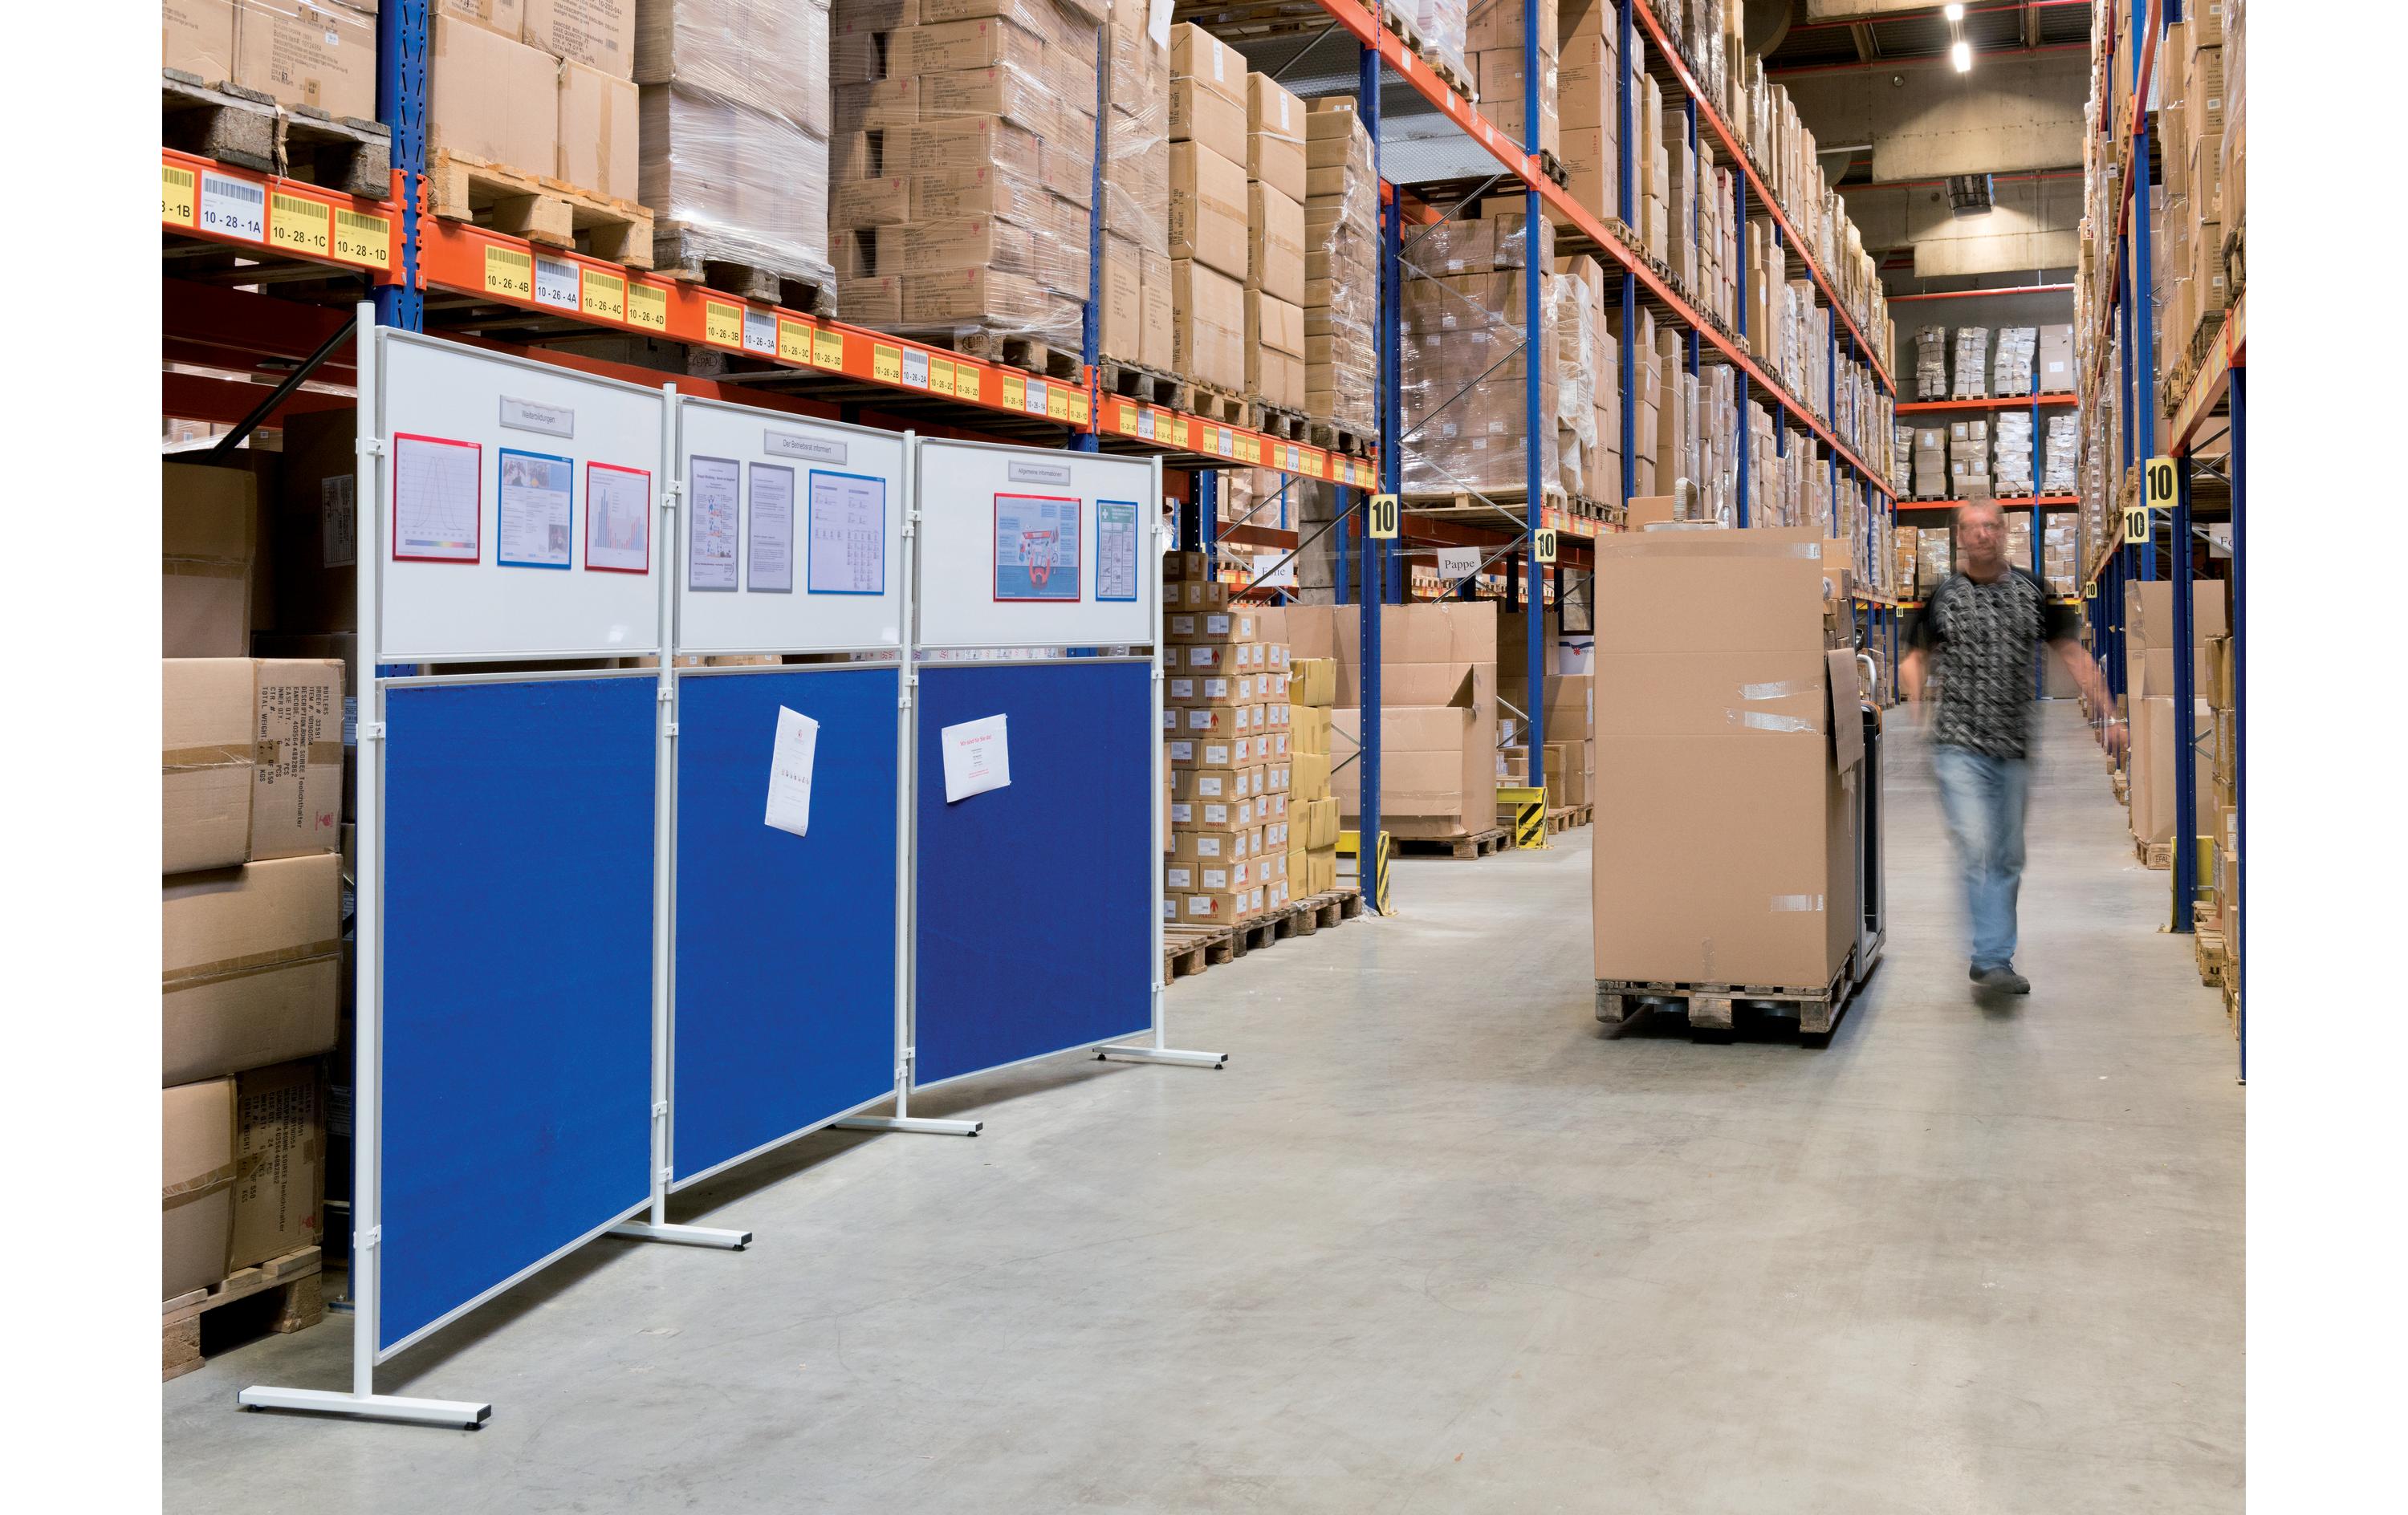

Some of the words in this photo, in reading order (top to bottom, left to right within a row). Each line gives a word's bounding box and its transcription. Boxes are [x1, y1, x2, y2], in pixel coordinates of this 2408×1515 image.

[177, 204, 190, 217] 1B
[204, 210, 216, 224] 10
[226, 215, 238, 228] 28
[248, 221, 261, 234] 1A
[273, 227, 284, 239] 10
[294, 231, 305, 244] 28
[314, 234, 326, 248] 1C
[337, 240, 348, 253] 10
[356, 245, 367, 257] 28
[376, 248, 386, 261] 1D
[488, 274, 496, 285] 10
[504, 278, 513, 289] 26
[519, 281, 529, 293] 4B
[538, 286, 546, 297] 10
[553, 290, 561, 300] 26
[567, 292, 577, 304] 4A
[585, 298, 593, 308] 10
[599, 301, 607, 311] 26
[612, 303, 622, 315] 4C
[629, 309, 637, 319] 10
[643, 311, 650, 322] 26
[655, 315, 664, 325] 4D
[708, 327, 714, 336] 10
[720, 329, 726, 339] 26
[745, 335, 752, 344] 10
[757, 337, 763, 346] 26
[781, 343, 787, 353] 10
[791, 346, 797, 355] 26
[815, 352, 820, 361] 10
[824, 354, 830, 363] 26
[791, 441, 813, 451] Betriebsrat
[814, 444, 831, 454] informiert
[1018, 468, 1038, 476] Allgemeine
[1039, 469, 1062, 477] Informationen
[2148, 465, 2172, 500] 10
[1373, 501, 1395, 532] 10
[2125, 511, 2145, 538] 10
[1538, 533, 1554, 557] 10
[1445, 558, 1475, 571] Pappe
[2087, 584, 2095, 595] 10
[285, 738, 290, 746] 24
[268, 1138, 273, 1147] 24
